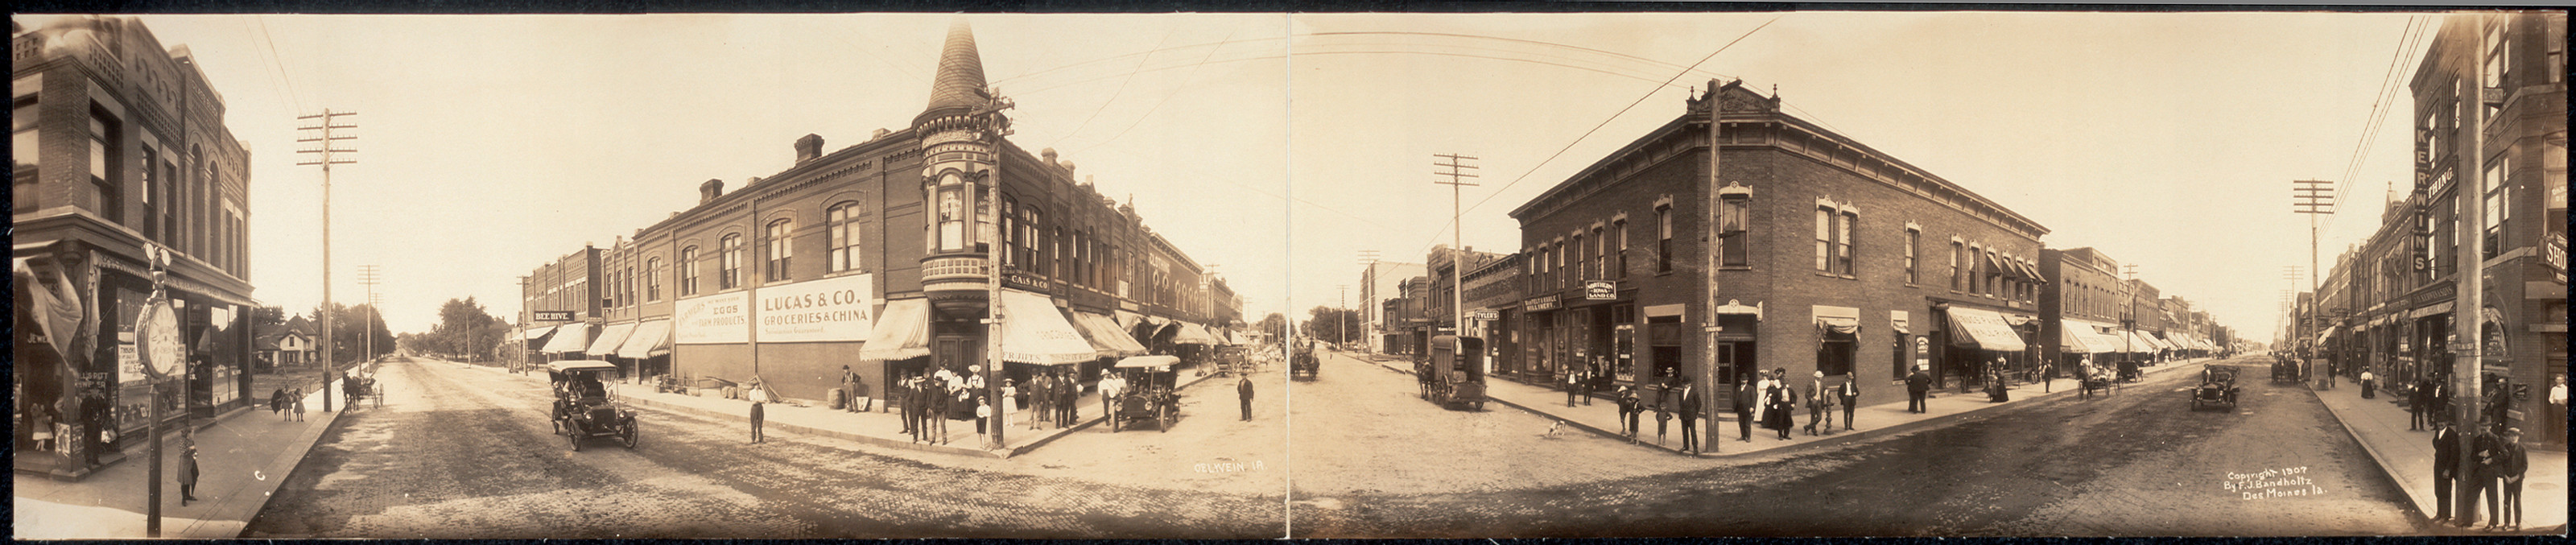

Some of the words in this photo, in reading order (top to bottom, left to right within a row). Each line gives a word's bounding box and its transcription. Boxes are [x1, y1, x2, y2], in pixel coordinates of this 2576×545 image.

[2415, 129, 2427, 270] KERWINS
[1587, 282, 1613, 290] NORTHERN
[766, 294, 812, 312] LUCAS
[818, 292, 828, 307] &
[833, 290, 861, 305] CO.
[713, 305, 738, 315] EGGS
[765, 312, 822, 325] GROCERIES
[824, 312, 830, 321] &
[832, 309, 868, 322] CHINA
